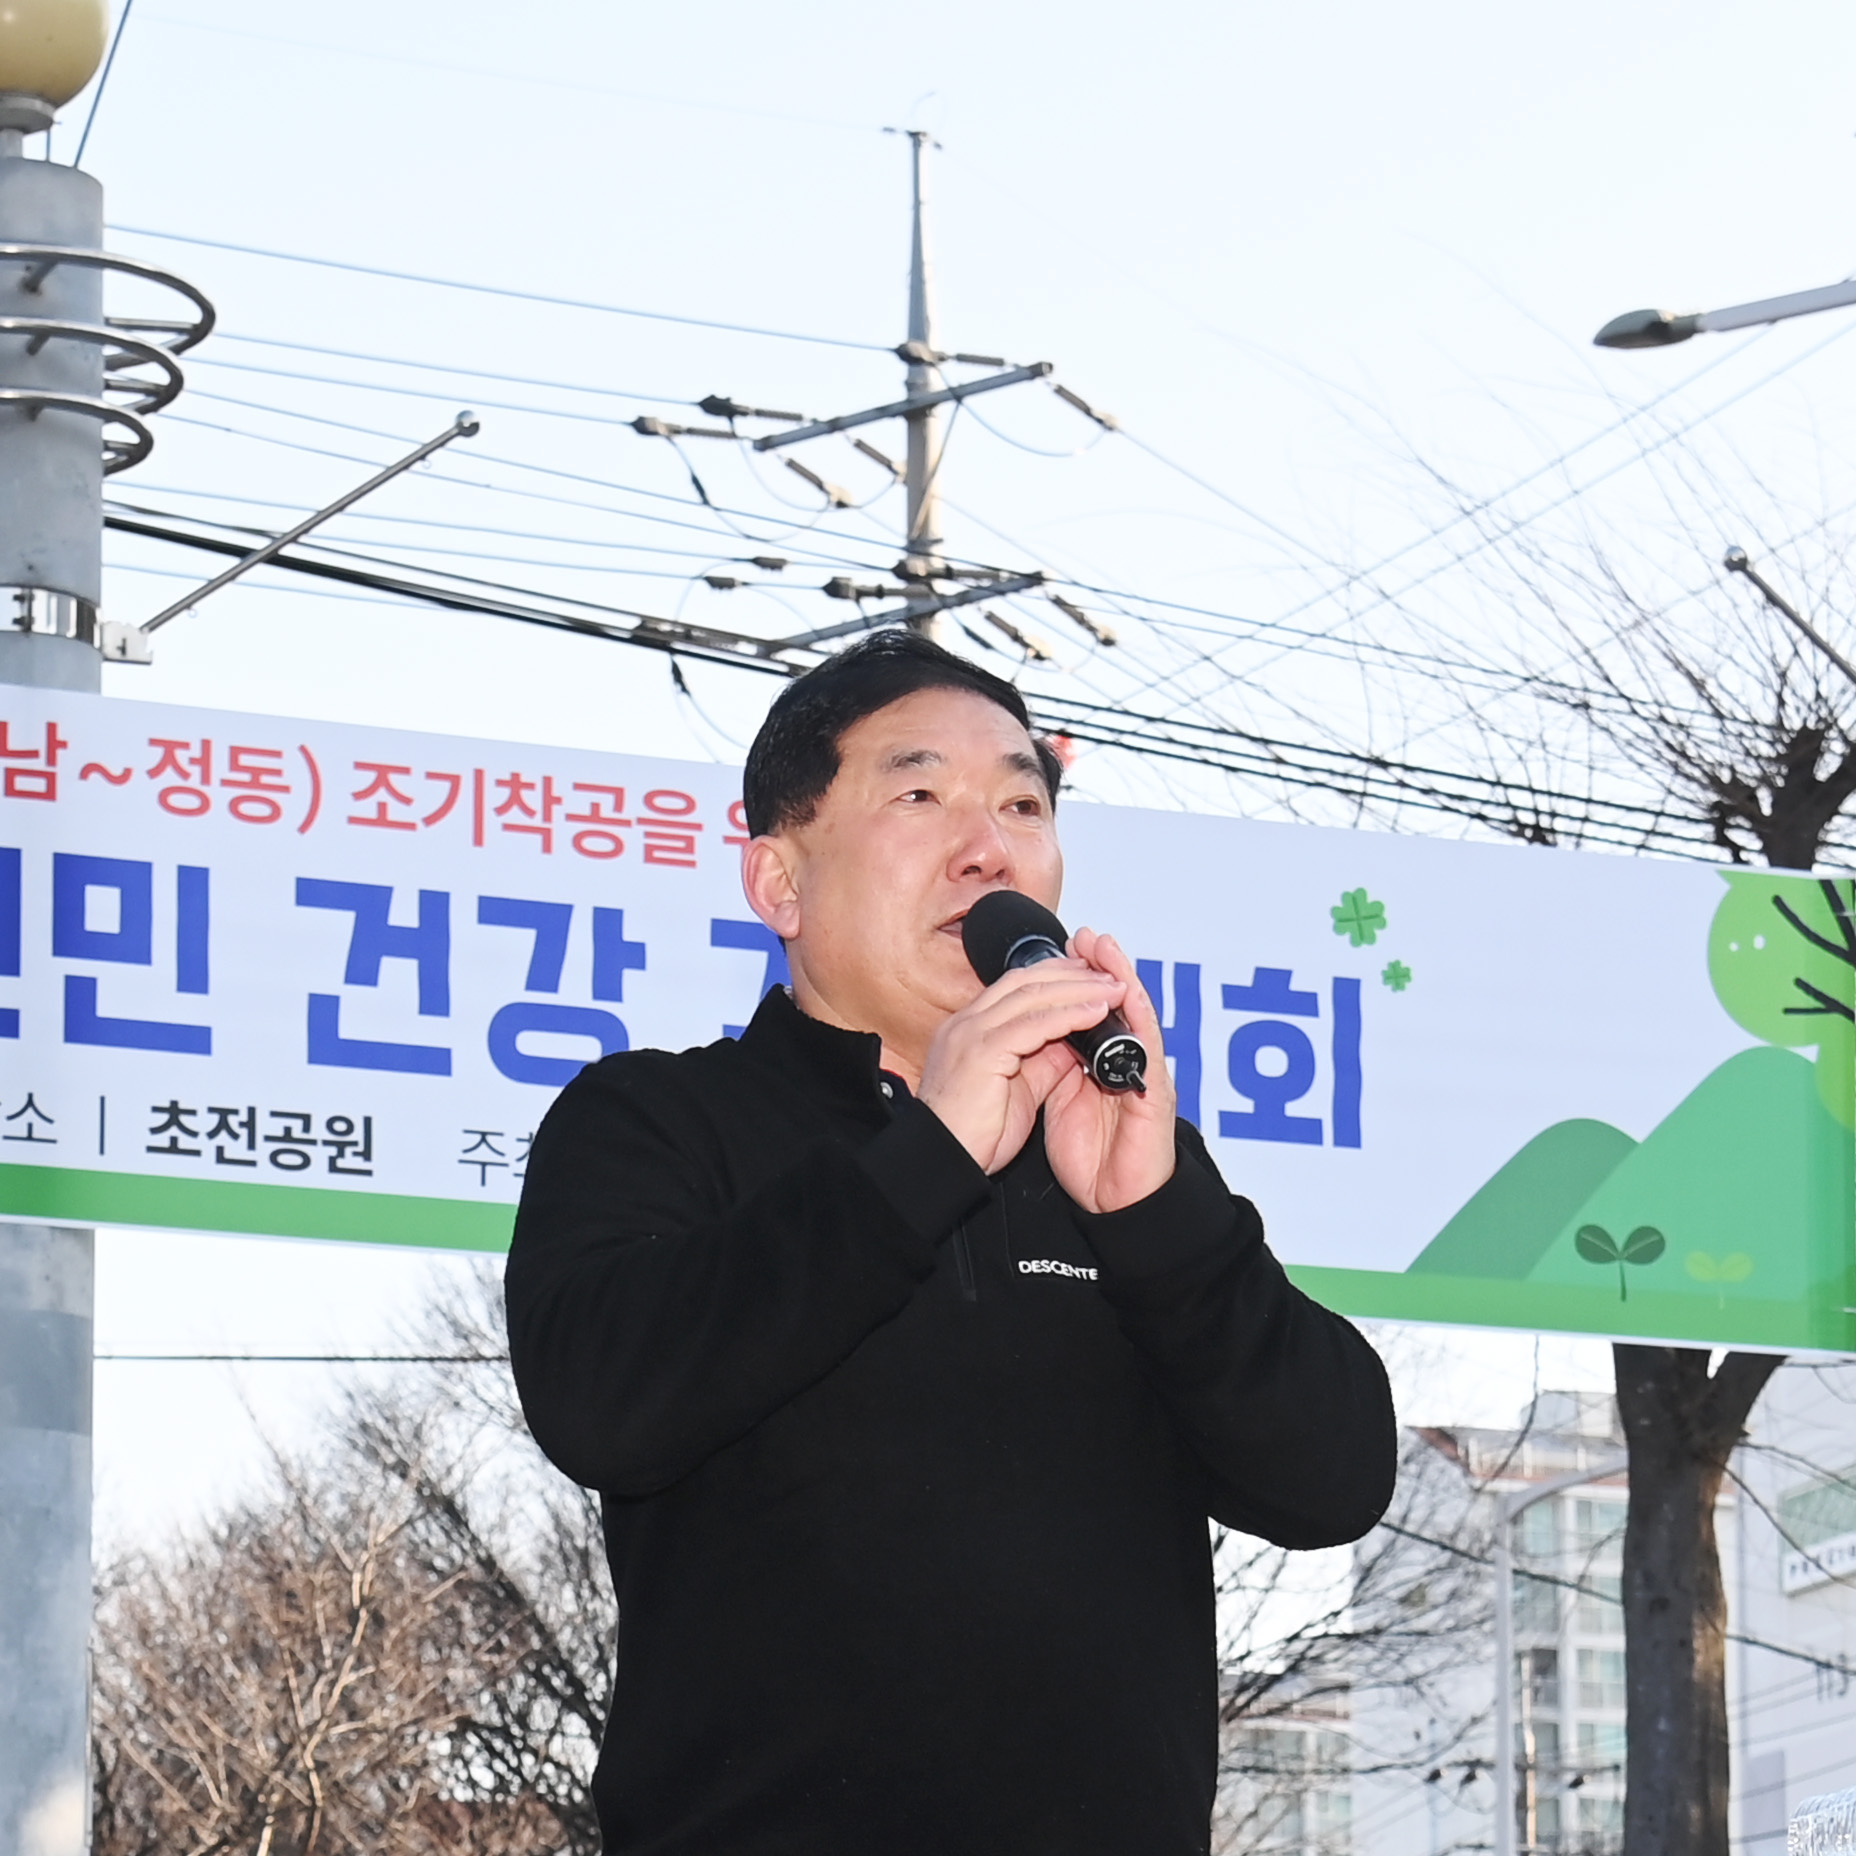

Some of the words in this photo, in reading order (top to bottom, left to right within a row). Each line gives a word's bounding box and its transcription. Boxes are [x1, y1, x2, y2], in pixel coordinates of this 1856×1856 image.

[346, 760, 704, 868] 조기착공을
[295, 877, 647, 1089] 건강
[145, 1104, 374, 1177] 초전공원
[1018, 1259, 1099, 1281] DESCENTE
